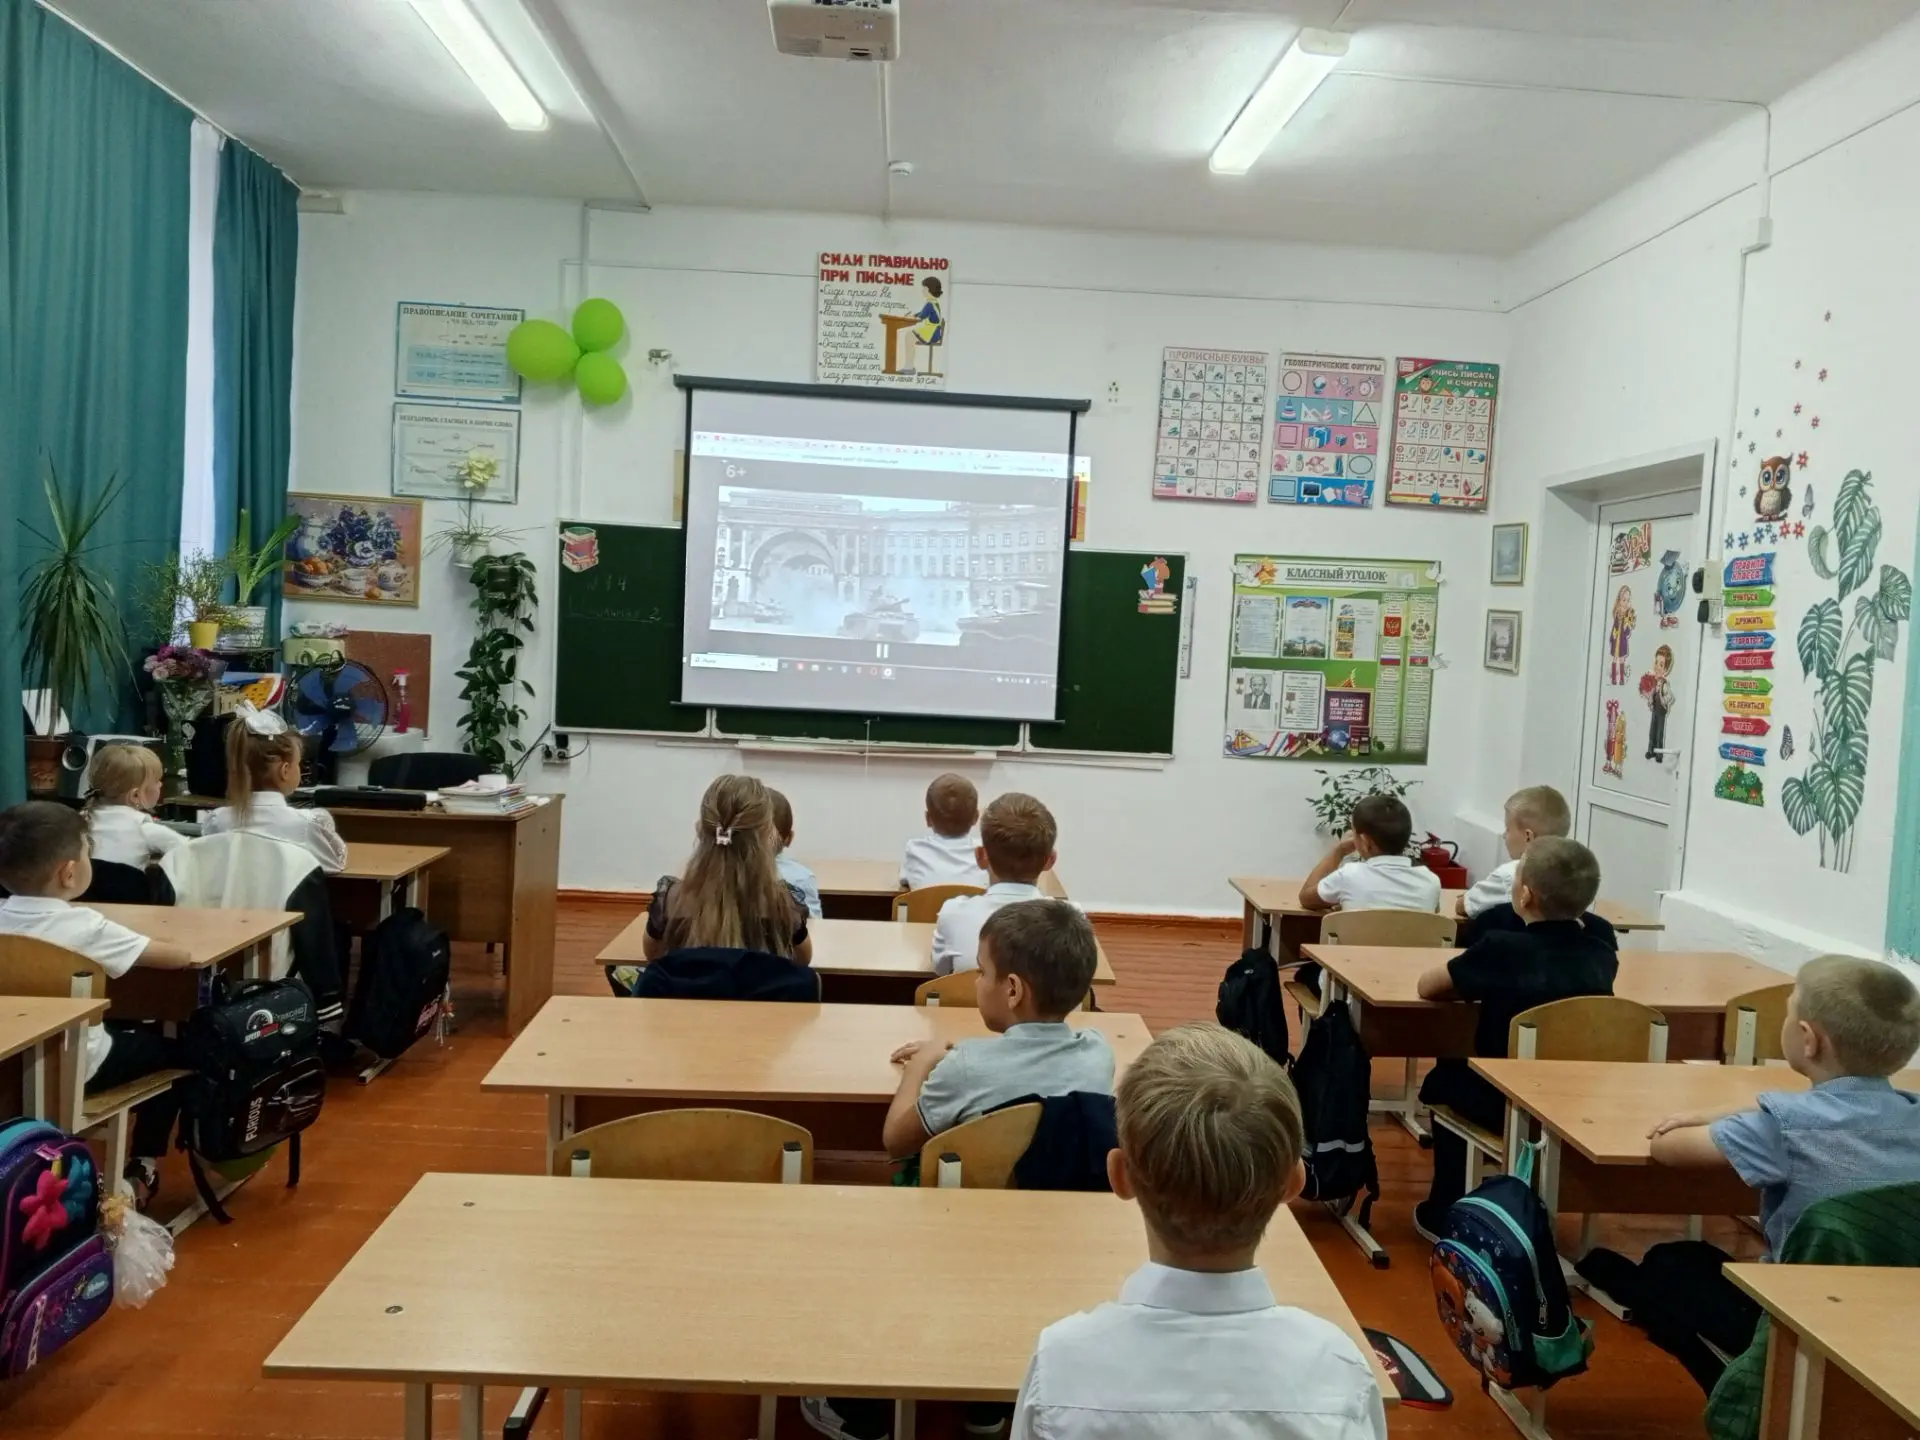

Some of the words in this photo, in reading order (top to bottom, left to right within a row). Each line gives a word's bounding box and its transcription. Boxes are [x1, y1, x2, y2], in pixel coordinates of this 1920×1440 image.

[820, 253, 863, 267] СИДИ
[868, 255, 949, 270] ПРАВИЛЬНО
[820, 269, 849, 282] ПРИ
[856, 271, 915, 286] ПИСЬМЕ
[403, 307, 468, 319] ПРАВОПИСАНИЕ
[470, 311, 518, 321] СОЧЕТАНИЙ
[1169, 351, 1230, 361] ПРОПИСНЫЕ
[1231, 354, 1265, 364] БУКВЫ
[1284, 358, 1349, 369] ГЕОМЕТРИЧЕСКИЕ
[1350, 362, 1382, 372] ФИГУРЫ
[1431, 369, 1459, 378] УЧИСЬ
[1460, 371, 1495, 380] ПИСАТЬ
[1454, 379, 1494, 389] СЧИТАТЬ
[726, 465, 747, 478] 6+
[1732, 558, 1766, 571] ПРАВИЛА
[1286, 567, 1343, 580] КЛАССНЫЙ
[1344, 570, 1387, 582] УГОЛОК
[1732, 593, 1759, 601] УЧИТЬСЯ
[1734, 617, 1764, 626] ДРУЖИТЬ
[1728, 700, 1737, 709] НЕ
[1737, 701, 1765, 710] ЛЕНИТЬСЯ
[245, 1096, 264, 1142] FURIOUS
